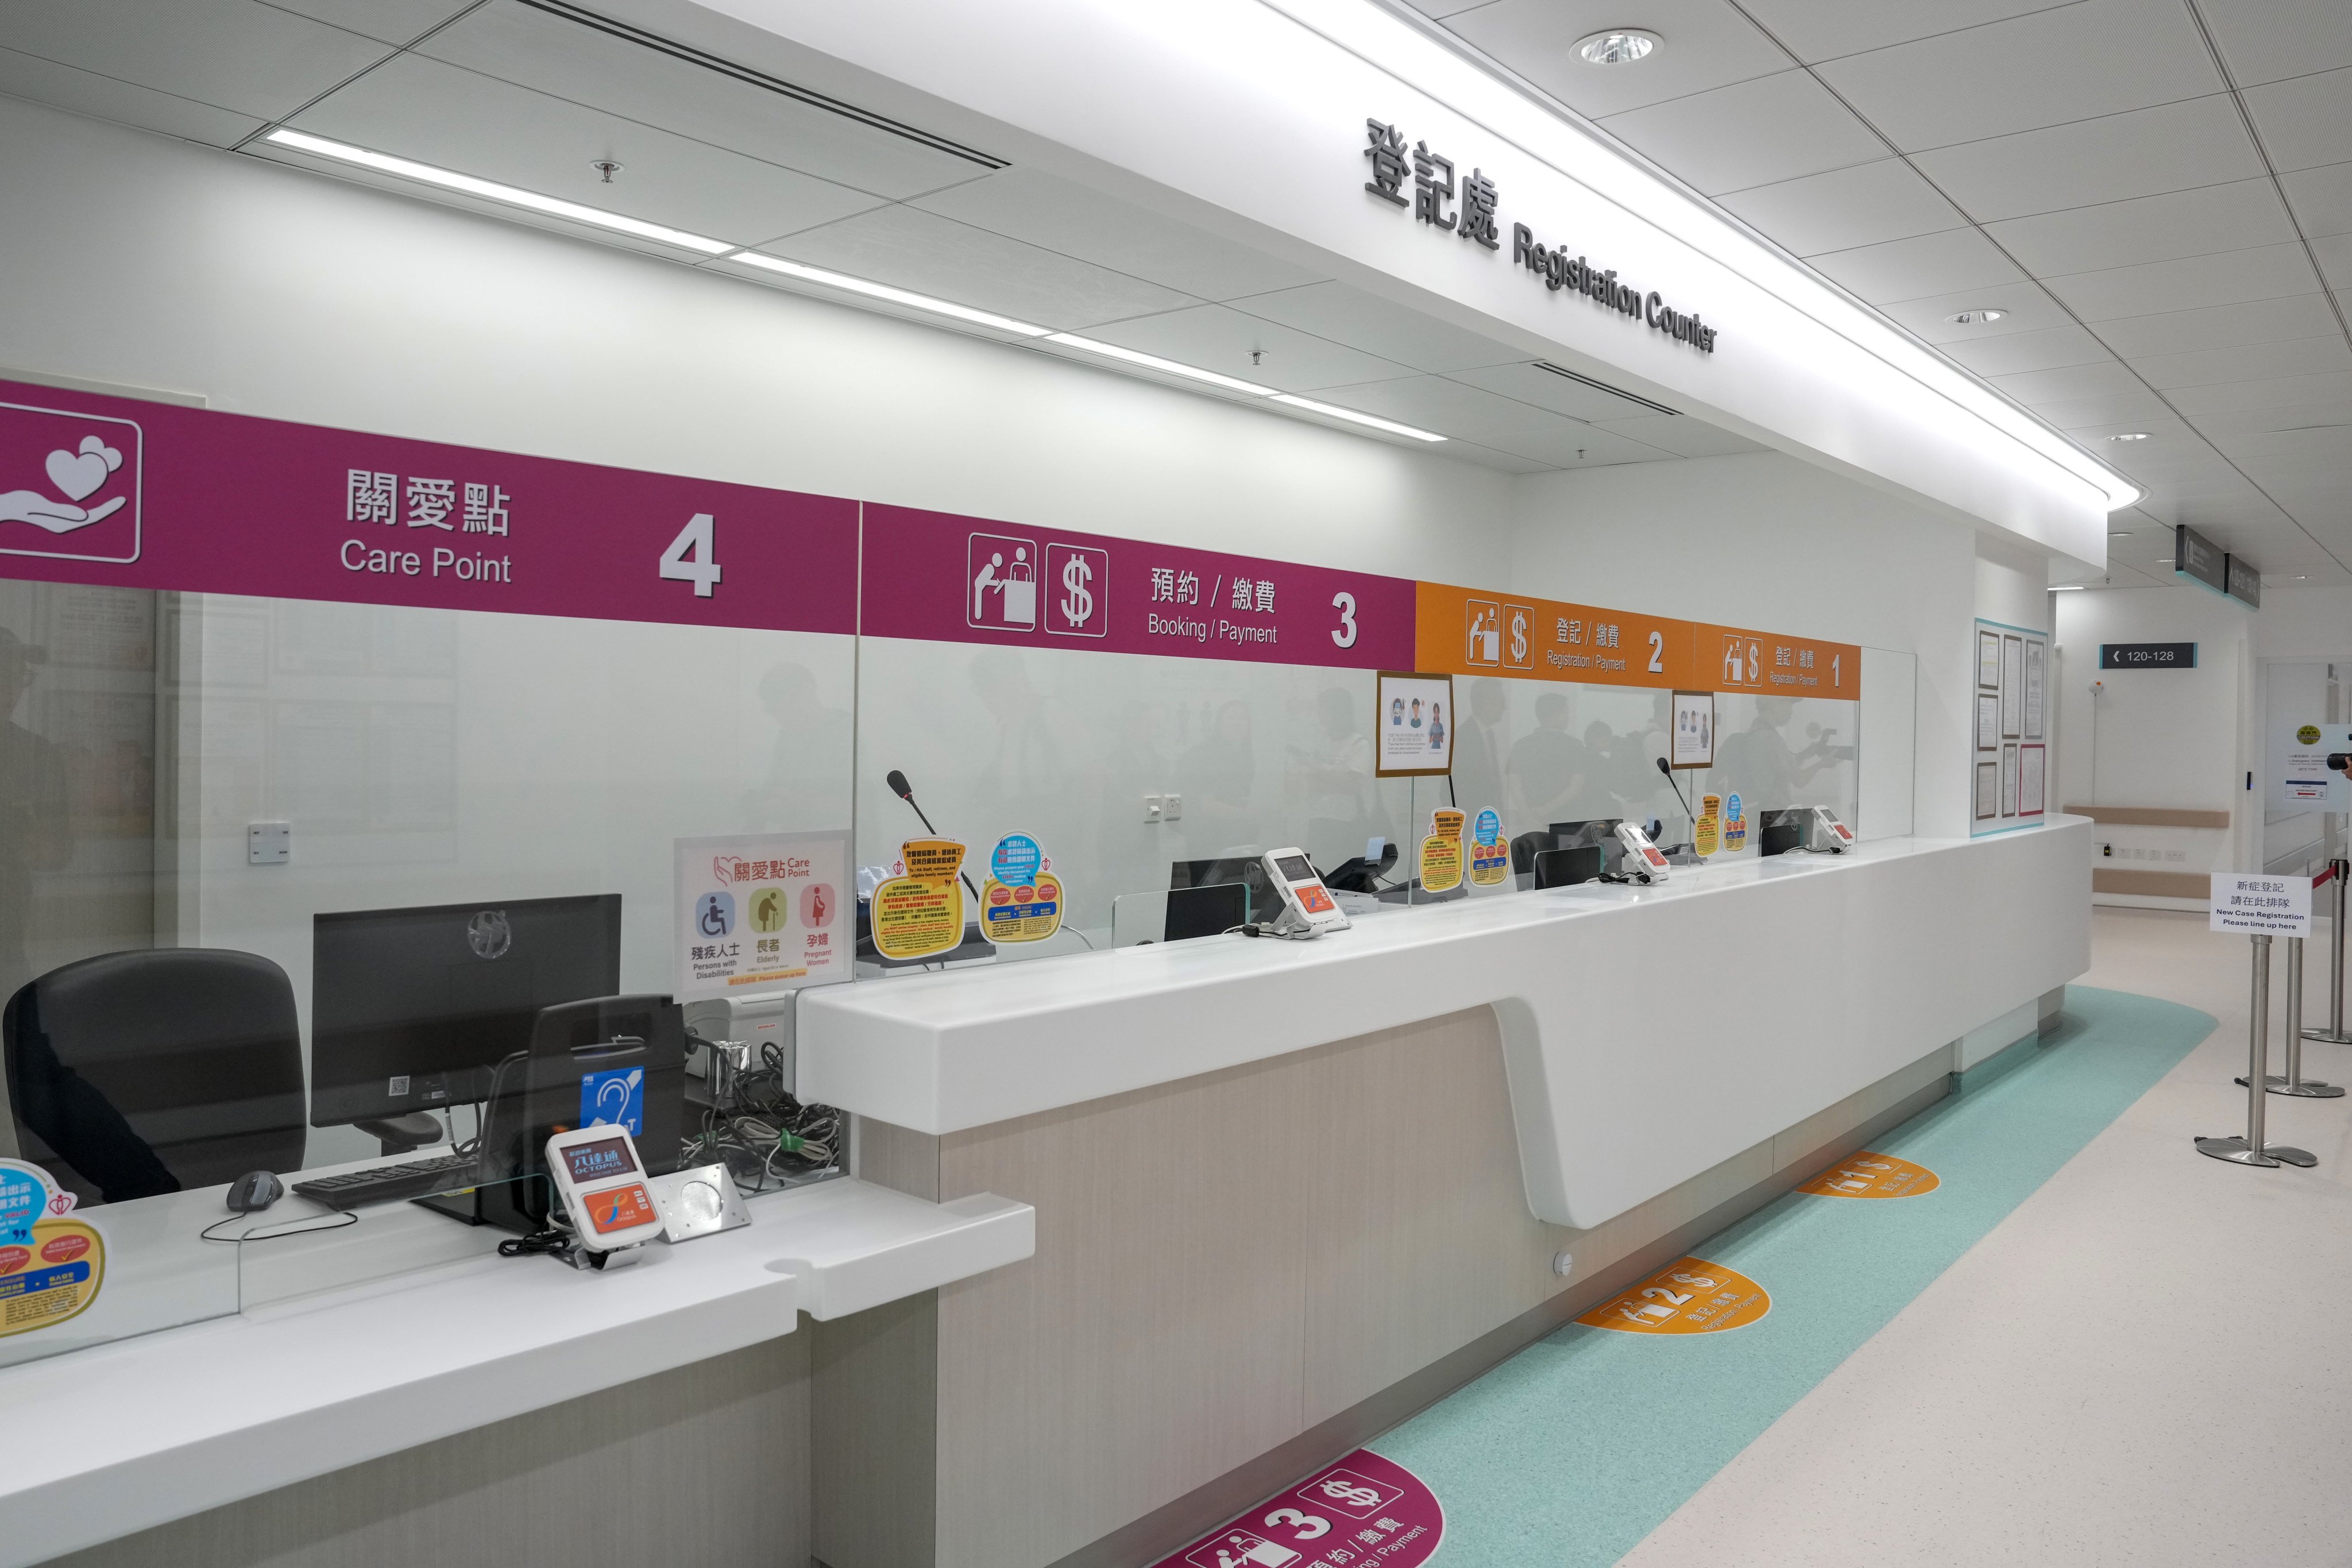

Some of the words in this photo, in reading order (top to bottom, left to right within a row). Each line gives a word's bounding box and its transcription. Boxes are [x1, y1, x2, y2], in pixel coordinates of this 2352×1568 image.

[1364, 117, 1500, 250] 登記處
[1513, 222, 1642, 320] Registration
[1646, 291, 1717, 353] Counter
[346, 469, 512, 537] 關愛點
[340, 539, 422, 576] Care
[432, 547, 512, 583] Point
[659, 513, 721, 597] 4
[1151, 568, 1200, 605] 預約
[1232, 577, 1276, 614] 繳費
[1148, 614, 1207, 643] Booking
[1220, 620, 1278, 646] Payment
[1331, 592, 1358, 649] 3
[1556, 617, 1581, 646] 登記
[1596, 623, 1619, 650] 繳費
[1547, 650, 1590, 669] Registration
[1596, 654, 1626, 673] Payment
[1648, 631, 1663, 673] 2
[1776, 646, 1791, 666] 登記
[1799, 649, 1814, 669] 繳費
[2127, 651, 2174, 661] 120-128
[1770, 671, 1796, 686] Registration
[1799, 674, 1818, 688] Payment
[1832, 654, 1840, 687] 1
[734, 860, 785, 882] 關愛點
[787, 858, 809, 868] Care
[788, 869, 809, 878] Point
[2237, 880, 2284, 893] 新症登記
[2231, 895, 2290, 908] 請在此排隊
[2257, 912, 2304, 920] Registration
[757, 939, 779, 953] 長者
[807, 933, 828, 947] 孕婦
[692, 943, 740, 960] 殘疾人士
[757, 955, 779, 963] Elderly
[804, 949, 832, 959] Pregnant
[693, 963, 721, 971] Persons
[697, 969, 734, 979] Disabilities
[574, 1150, 620, 1168] 八達通
[575, 1160, 622, 1175] OCTOPUS
[5, 1209, 30, 1218] VALID
[1641, 1287, 1694, 1306] 2
[1686, 1307, 1717, 1322] 登記
[1701, 1310, 1738, 1331] Registration
[1734, 1292, 1763, 1310] Payment
[1264, 1508, 1334, 1540] 3
[1355, 1516, 1405, 1545] 繳費
[1377, 1524, 1428, 1557] Payment
